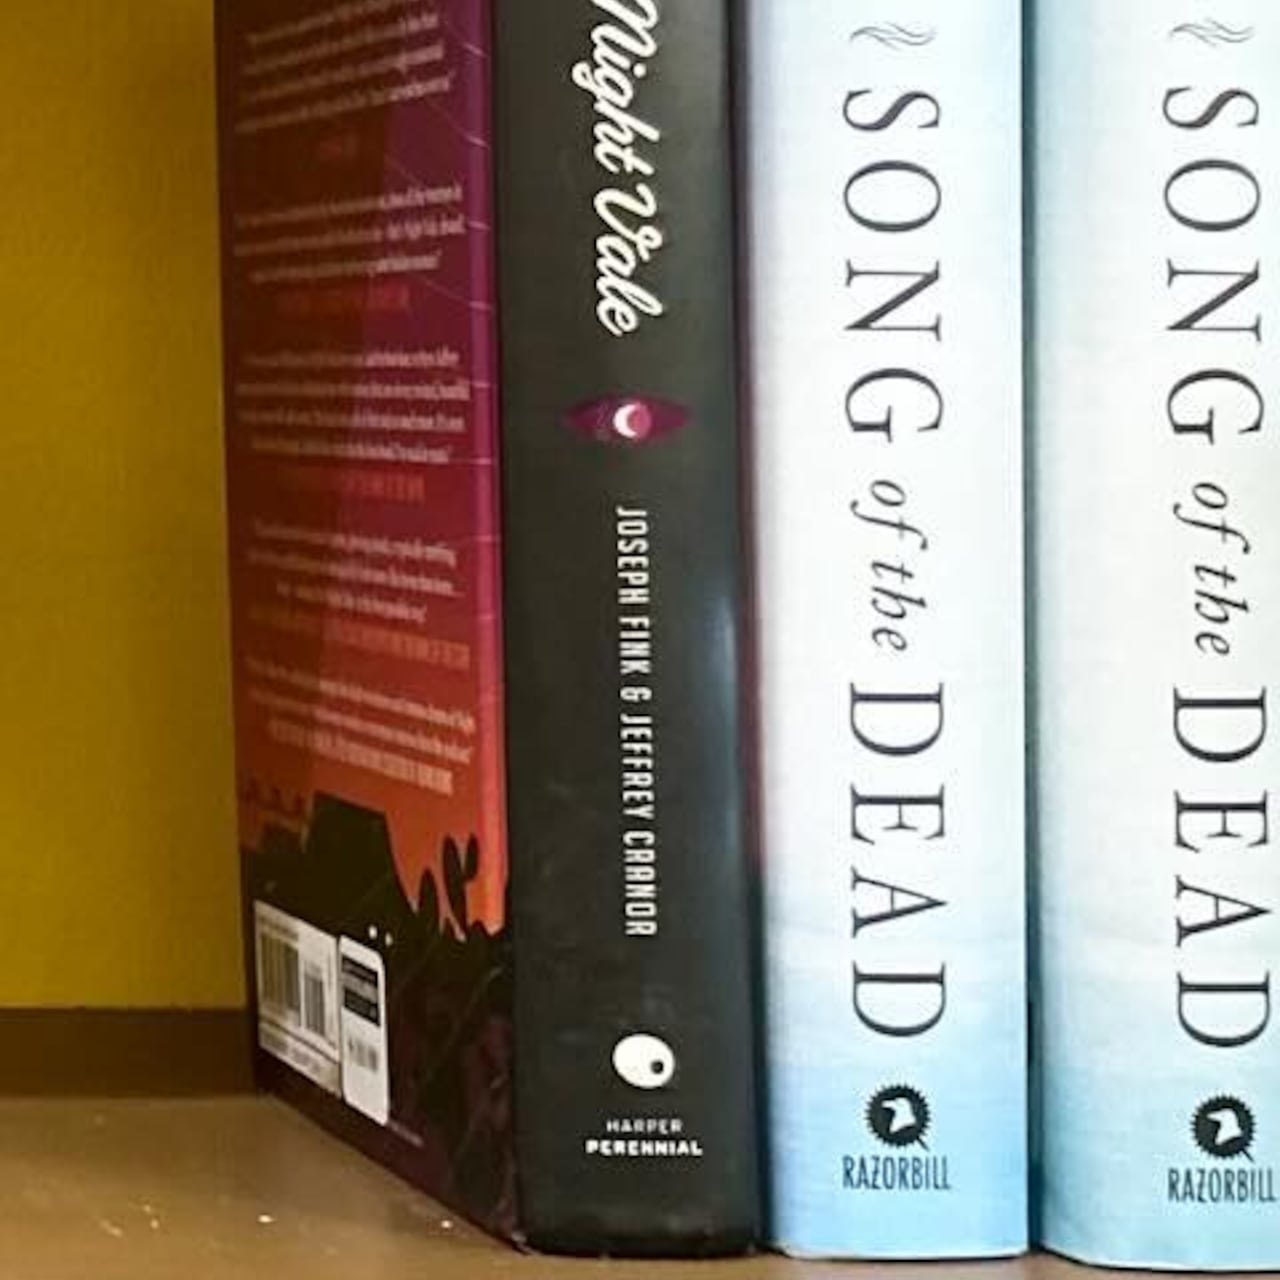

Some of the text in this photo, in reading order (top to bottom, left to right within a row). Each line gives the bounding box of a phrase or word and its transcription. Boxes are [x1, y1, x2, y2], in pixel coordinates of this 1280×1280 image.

[591, 172, 665, 337] Vale
[842, 86, 949, 1039] SONG of the DEAD
[1162, 85, 1272, 1050] SONG of the DEAD
[615, 505, 659, 937] JOSEPH FINK JEFFREY CRANOR
[585, 1138, 704, 1158] PERENNIAL
[606, 1119, 684, 1135] HARPER
[842, 1154, 952, 1192] RAZORBILL
[1167, 1166, 1277, 1206] RAZORBILL
